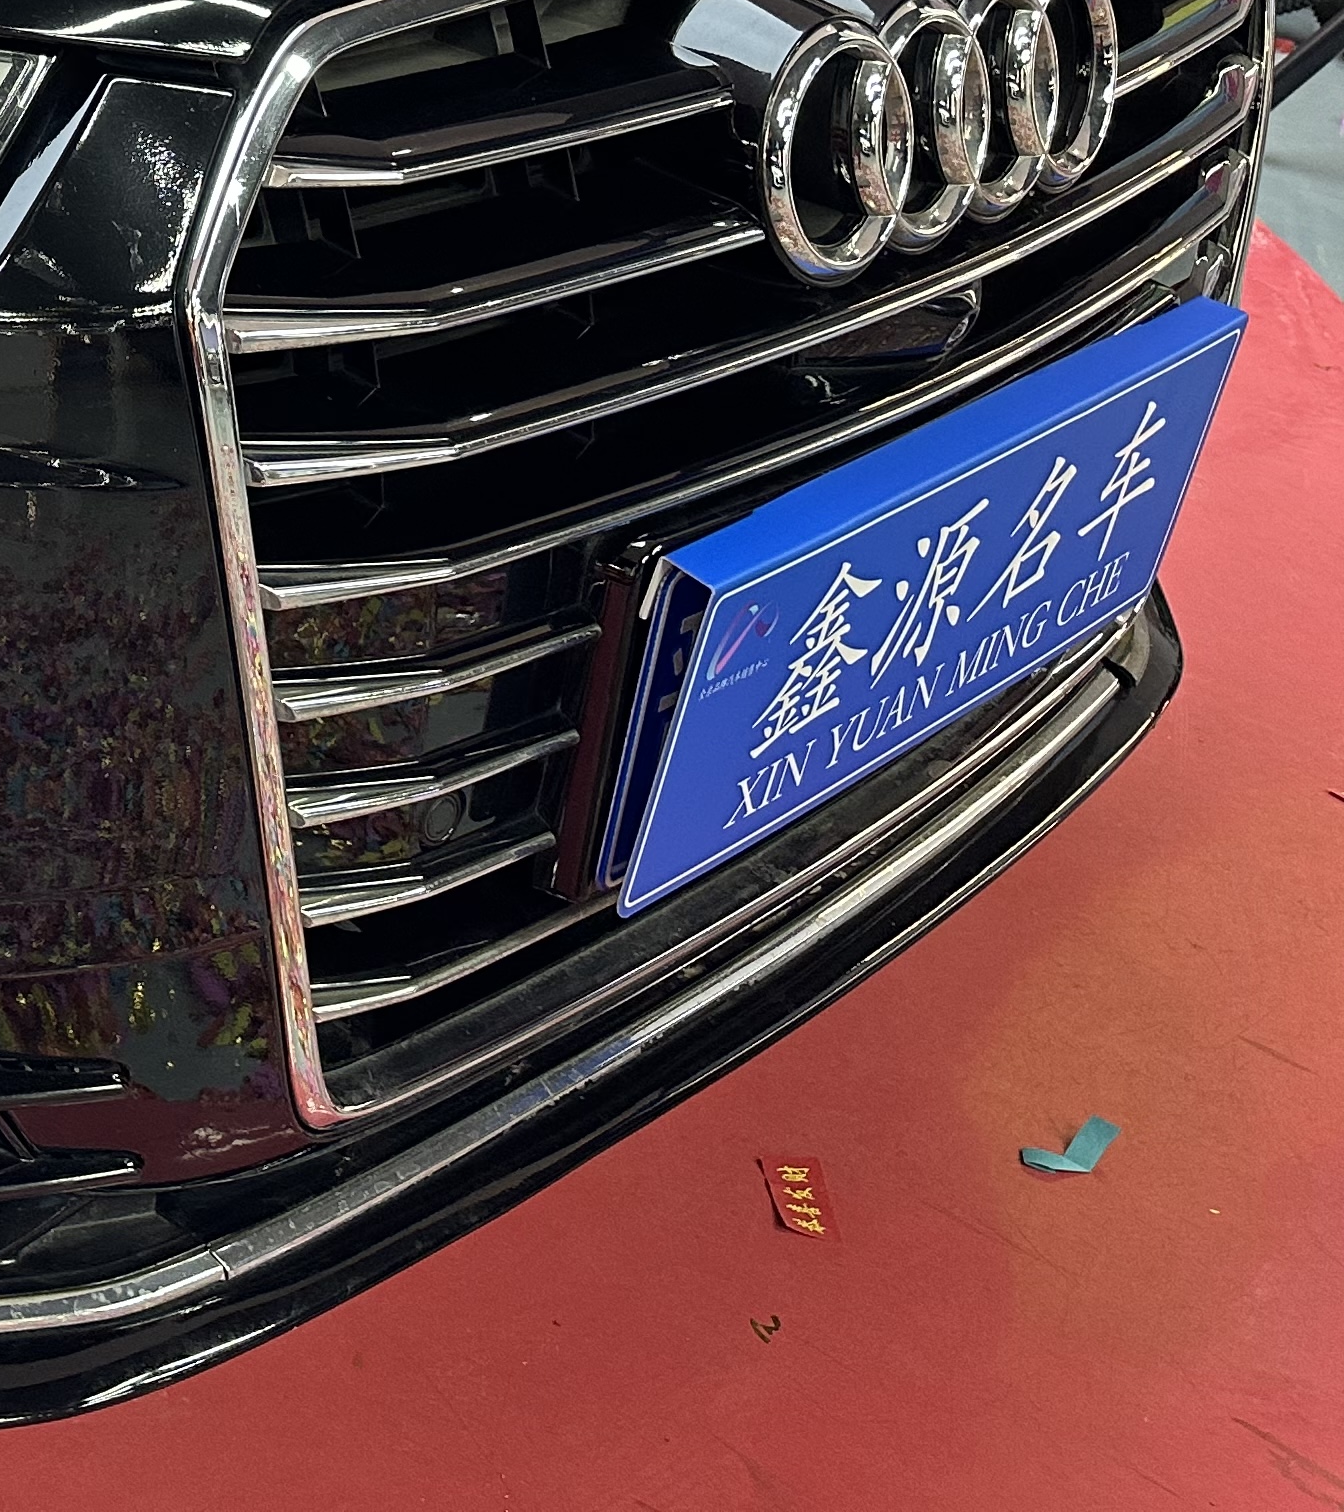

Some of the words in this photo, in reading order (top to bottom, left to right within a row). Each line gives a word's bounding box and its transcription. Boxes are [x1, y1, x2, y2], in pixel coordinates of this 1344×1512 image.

[722, 738, 818, 830] XIN
[825, 669, 939, 770] YUAN
[944, 600, 1055, 698] MING
[1054, 551, 1132, 634] CHE
[749, 399, 1167, 761] 鑫源名车
